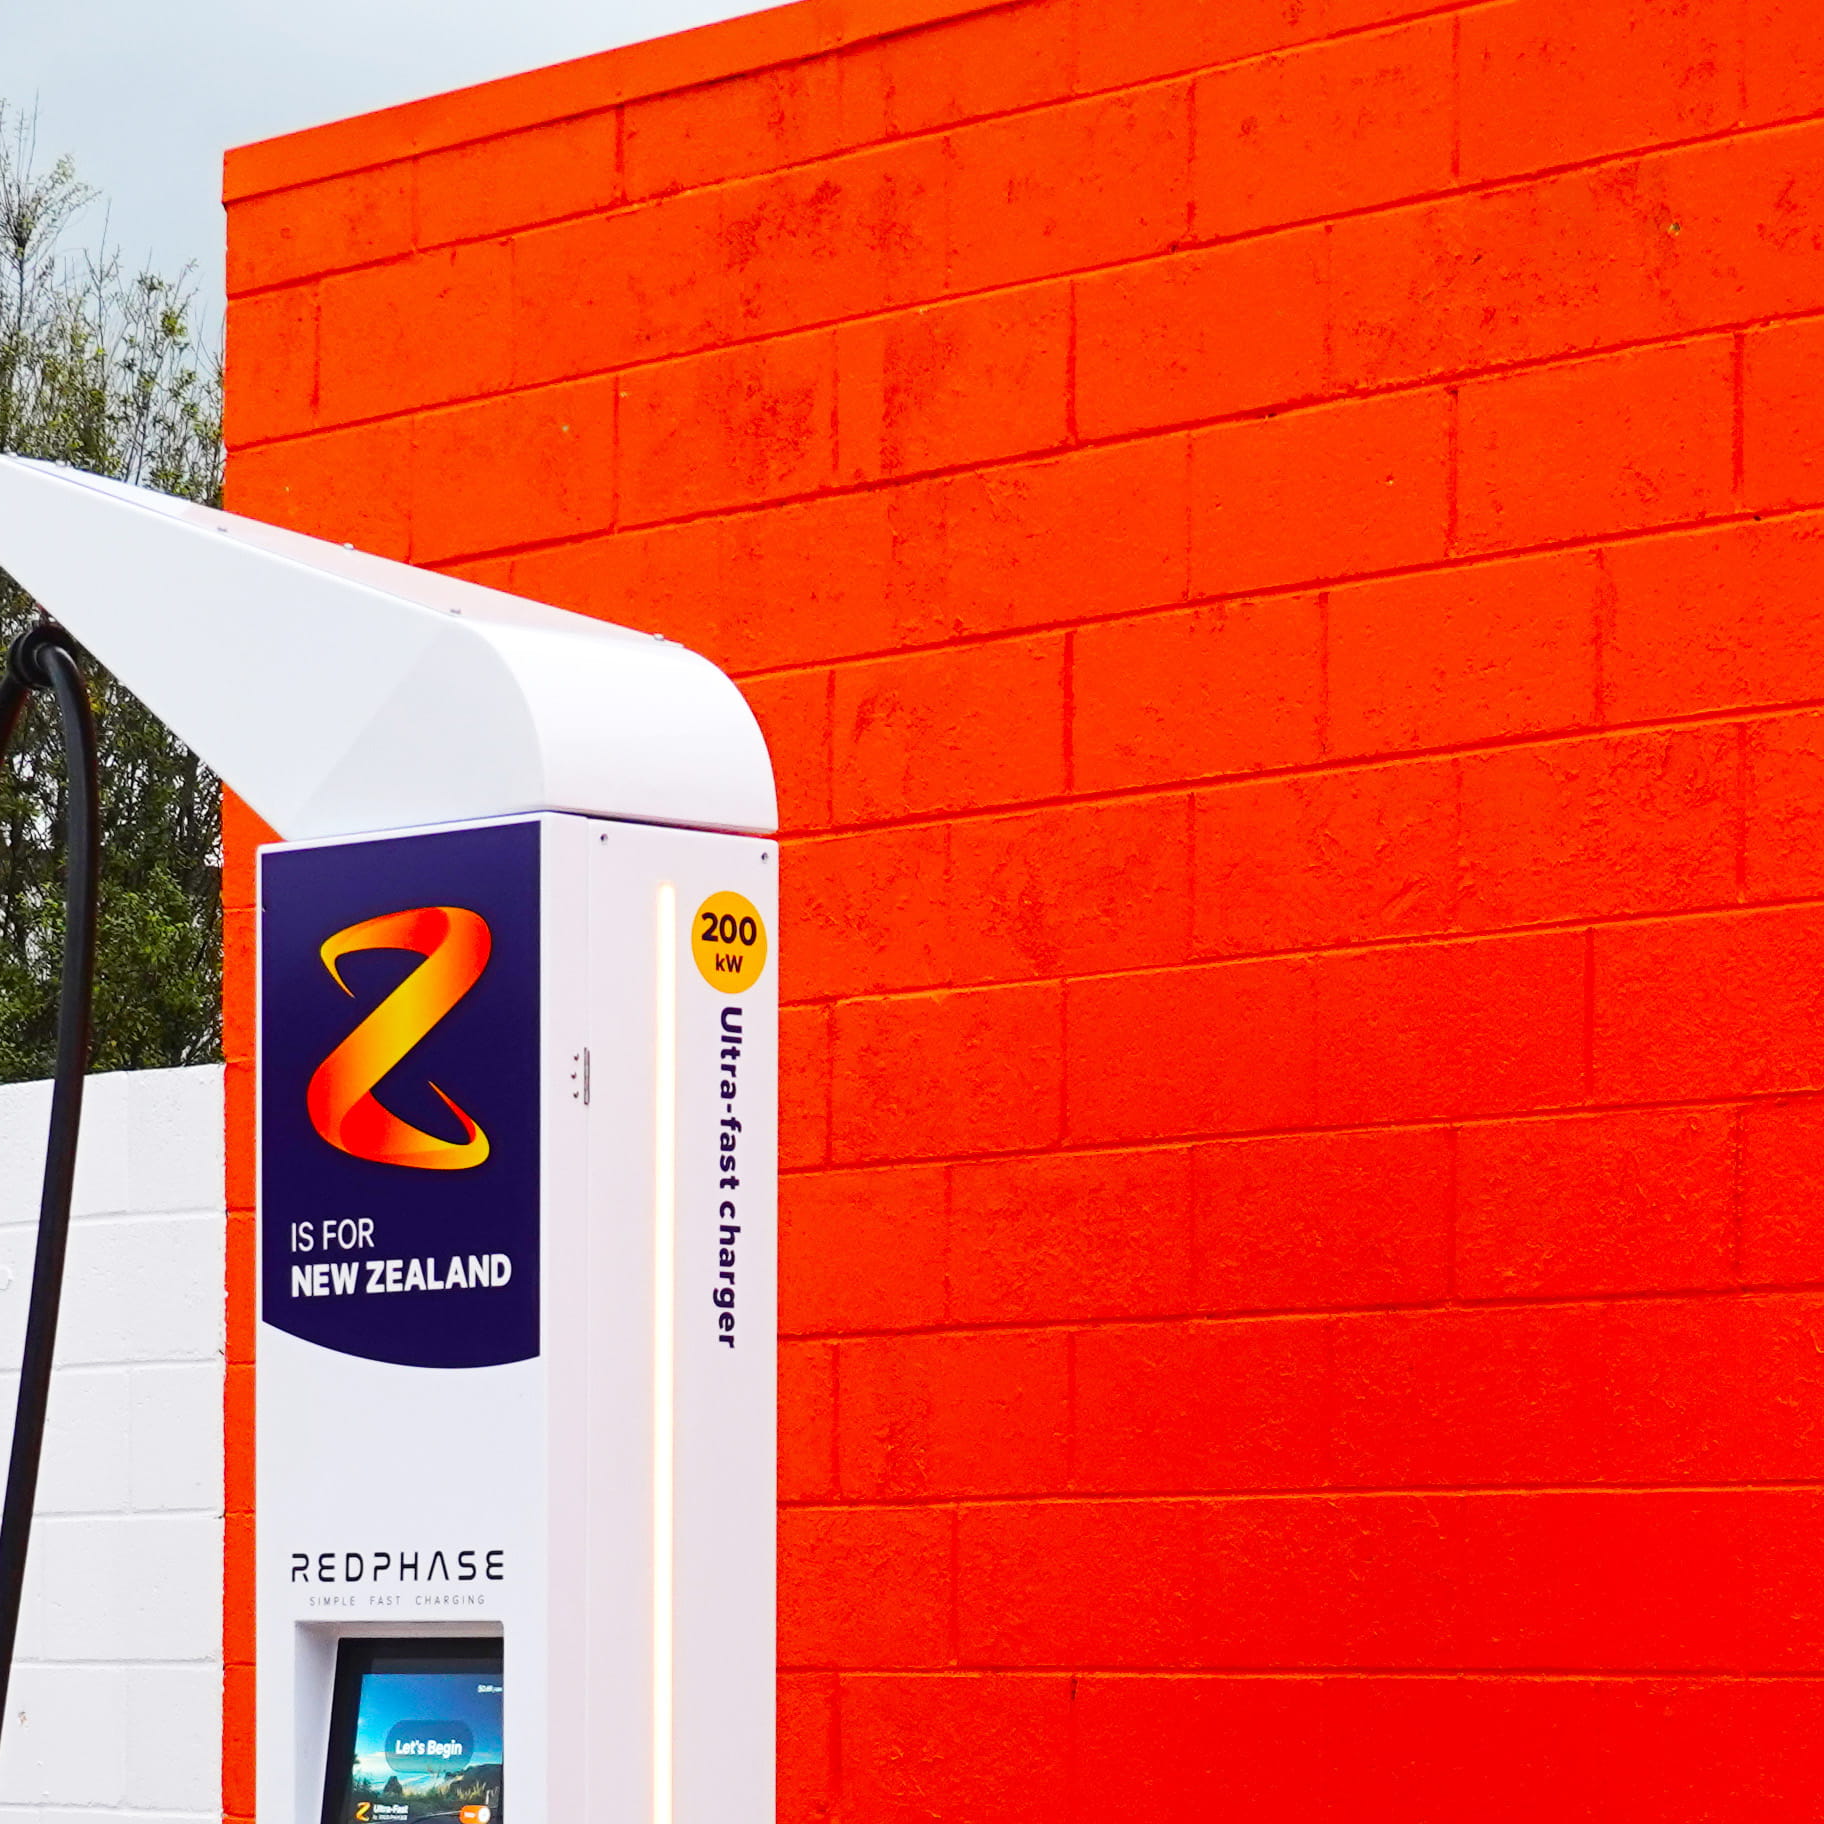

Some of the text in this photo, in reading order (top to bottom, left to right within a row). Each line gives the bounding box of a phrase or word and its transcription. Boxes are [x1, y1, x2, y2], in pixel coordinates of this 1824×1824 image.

[701, 912, 758, 945] 200
[715, 954, 744, 974] kW
[306, 906, 492, 1170] Z
[712, 1007, 744, 1349] Ultra-fast charger
[291, 1218, 375, 1253] IS FOR
[291, 1253, 512, 1298] NEW ZEALAND
[291, 1550, 504, 1583] REDPHASE
[309, 1594, 486, 1607] SIMPLE FAST CHARGING
[395, 1739, 462, 1759] Let's Begin
